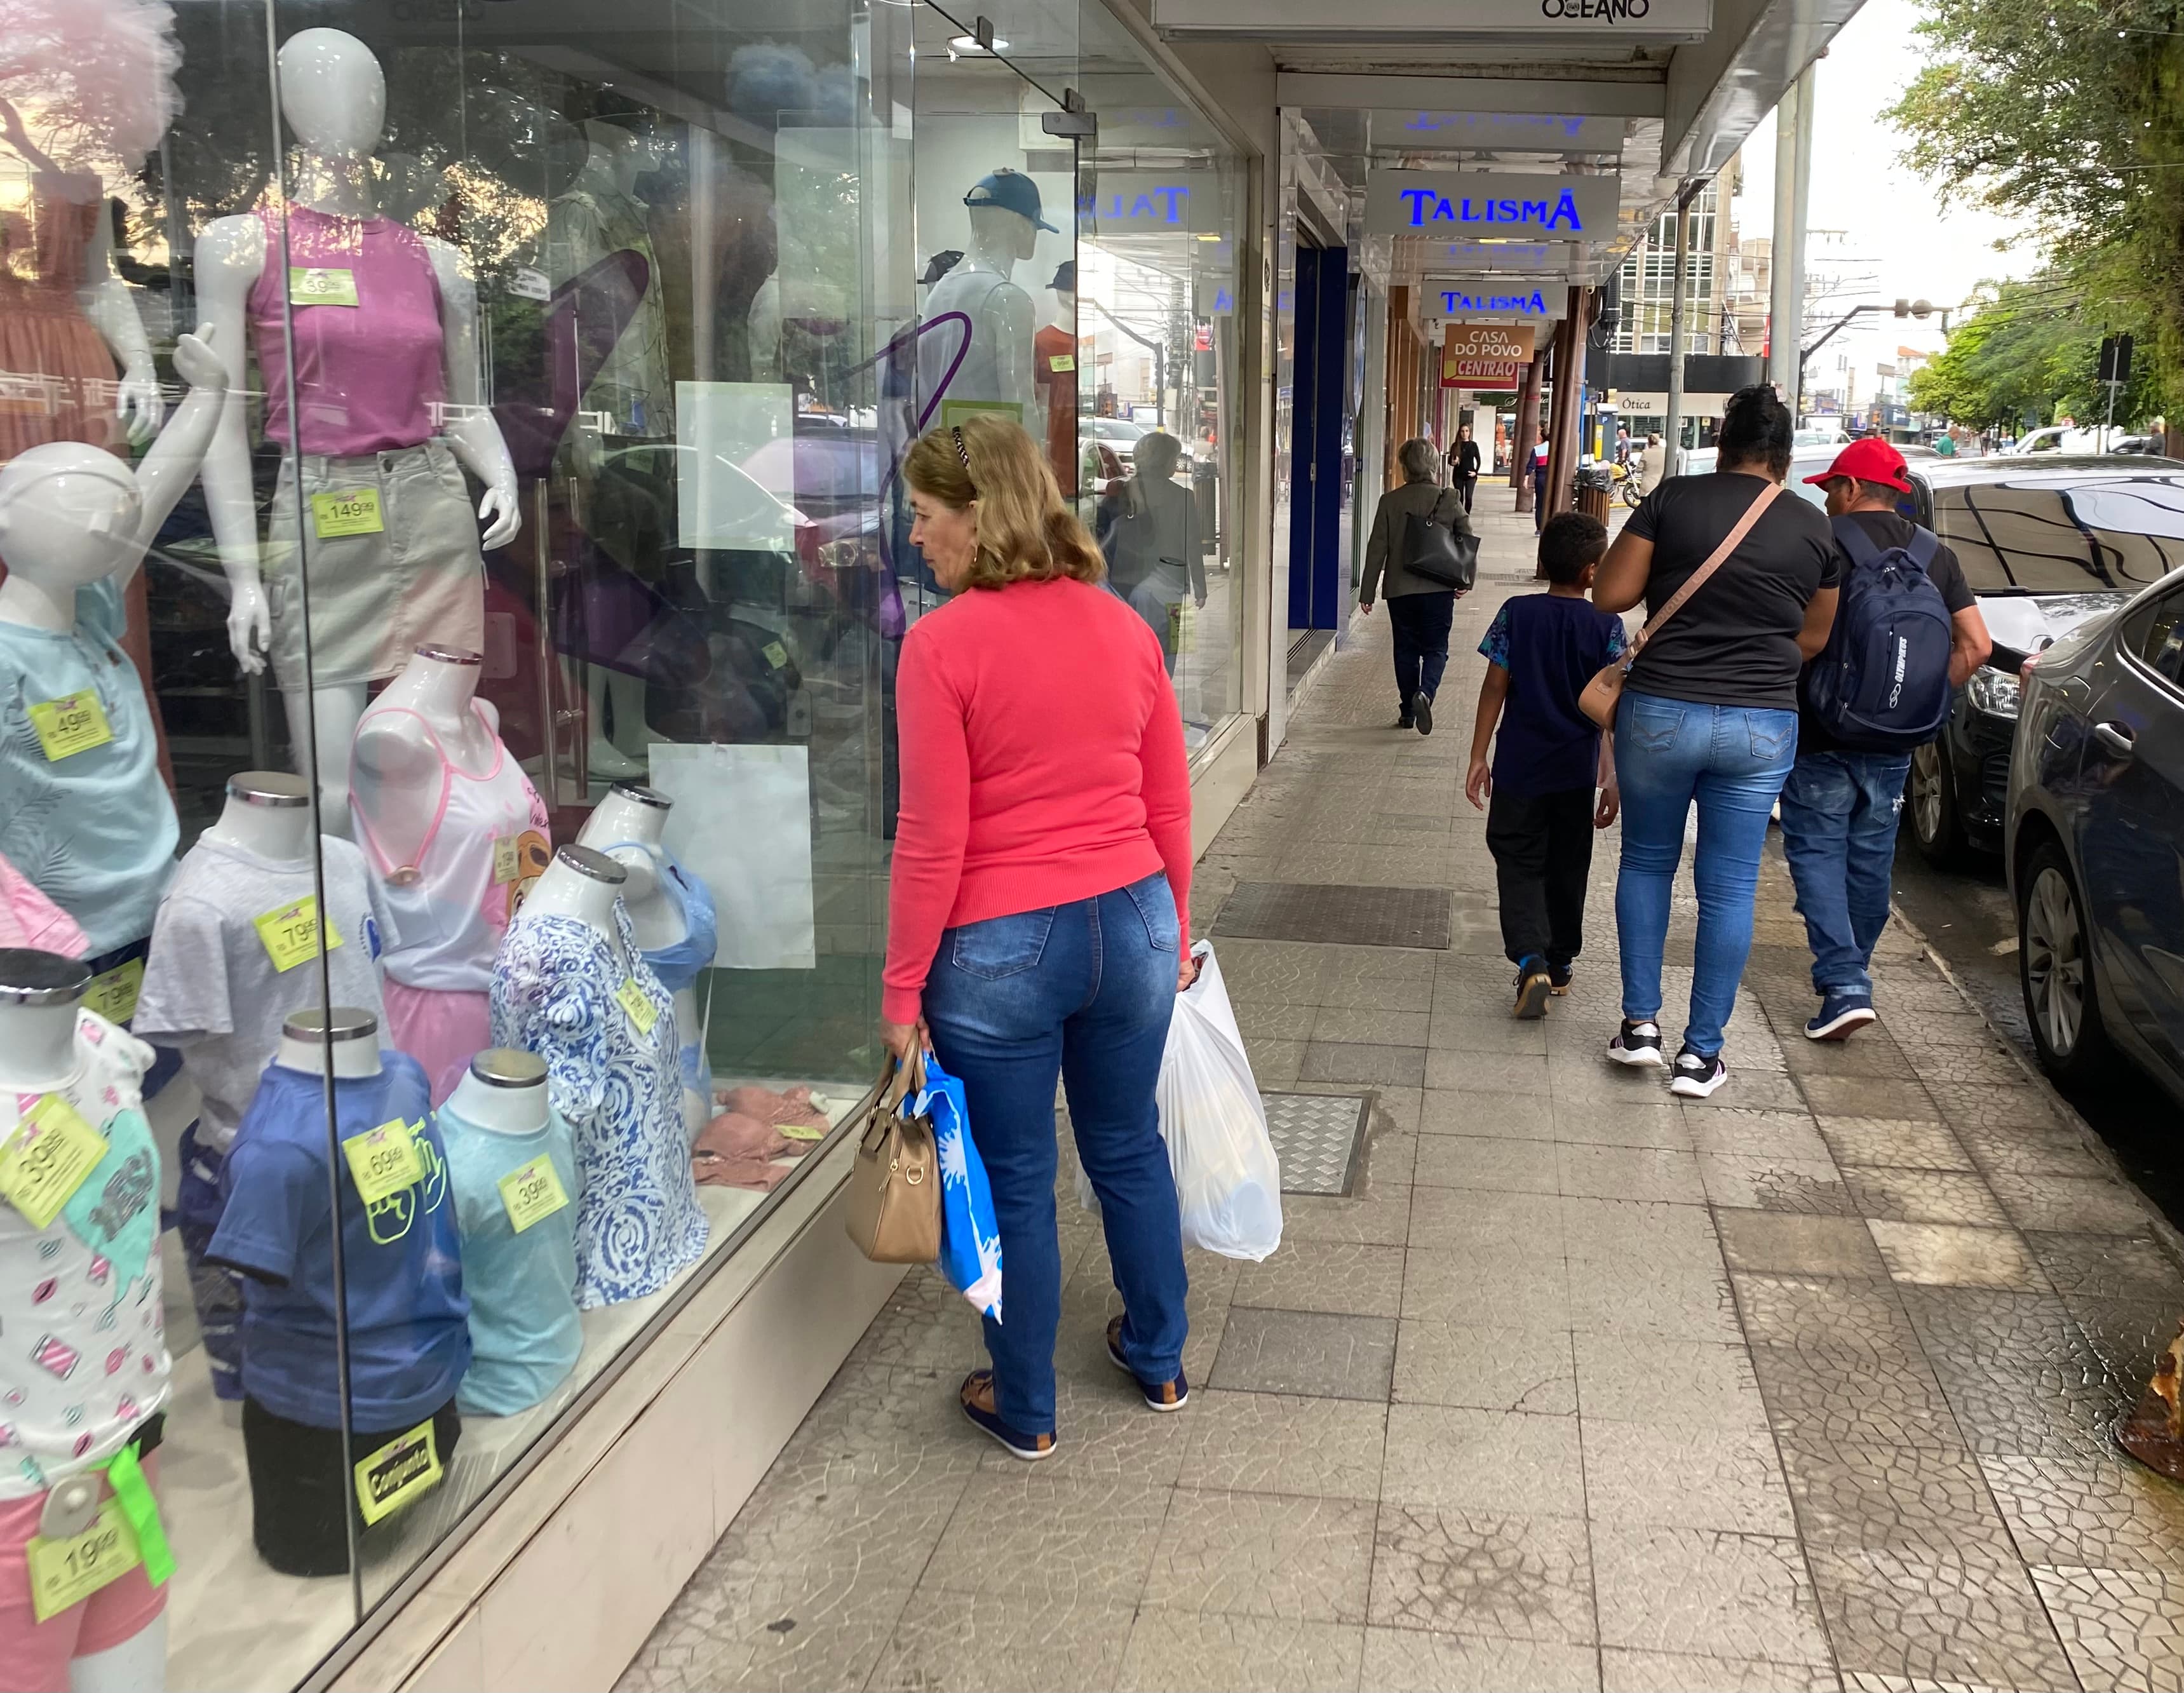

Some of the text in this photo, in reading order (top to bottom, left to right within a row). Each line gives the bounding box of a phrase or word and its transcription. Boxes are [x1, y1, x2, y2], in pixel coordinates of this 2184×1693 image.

[1542, 0, 1650, 25] OCEANO
[1399, 188, 1584, 231] TALISMÃ
[1440, 289, 1547, 314] TALISMÃ
[1469, 330, 1509, 344] CASA
[1455, 343, 1523, 357] DO POVO
